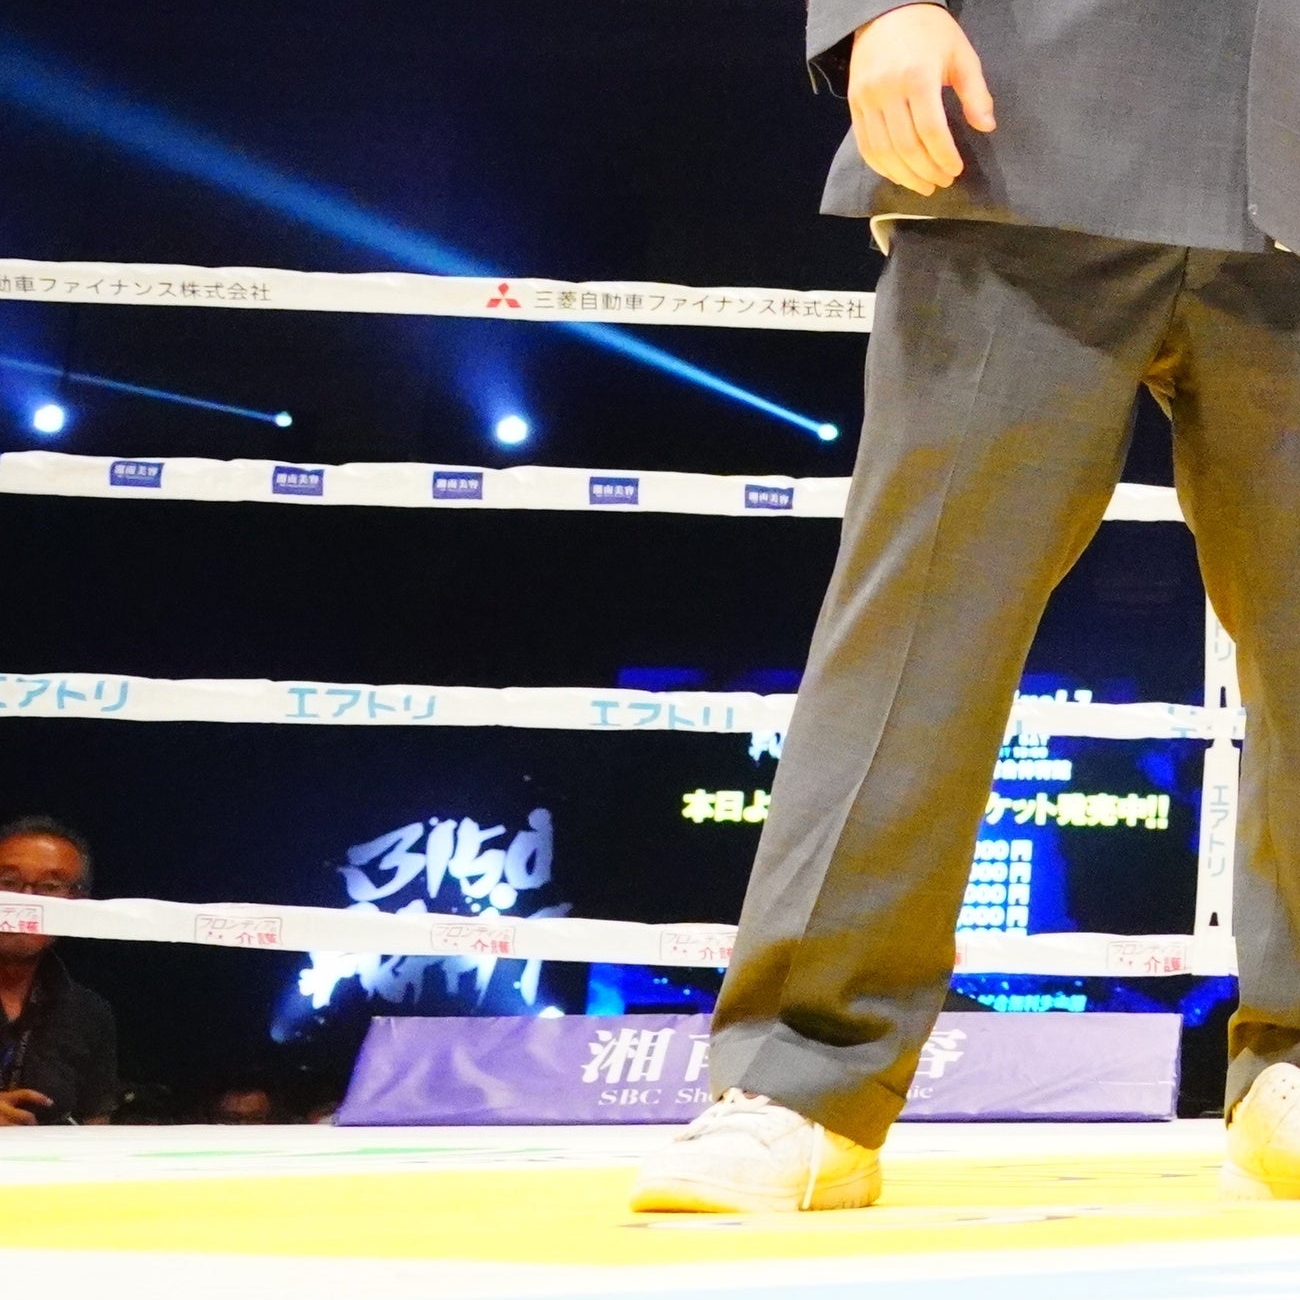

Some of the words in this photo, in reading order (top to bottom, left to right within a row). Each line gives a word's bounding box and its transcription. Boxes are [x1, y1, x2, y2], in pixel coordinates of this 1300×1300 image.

[533, 290, 867, 320] 三菱自動車ファイナンス株式会社
[285, 687, 437, 719] エアトリ
[589, 701, 735, 729] エアトリ
[1208, 785, 1230, 878] エアトリ
[234, 931, 278, 946] 介護
[471, 939, 511, 955] 介護
[1143, 956, 1183, 973] 介護
[598, 1088, 659, 1107] SBC
